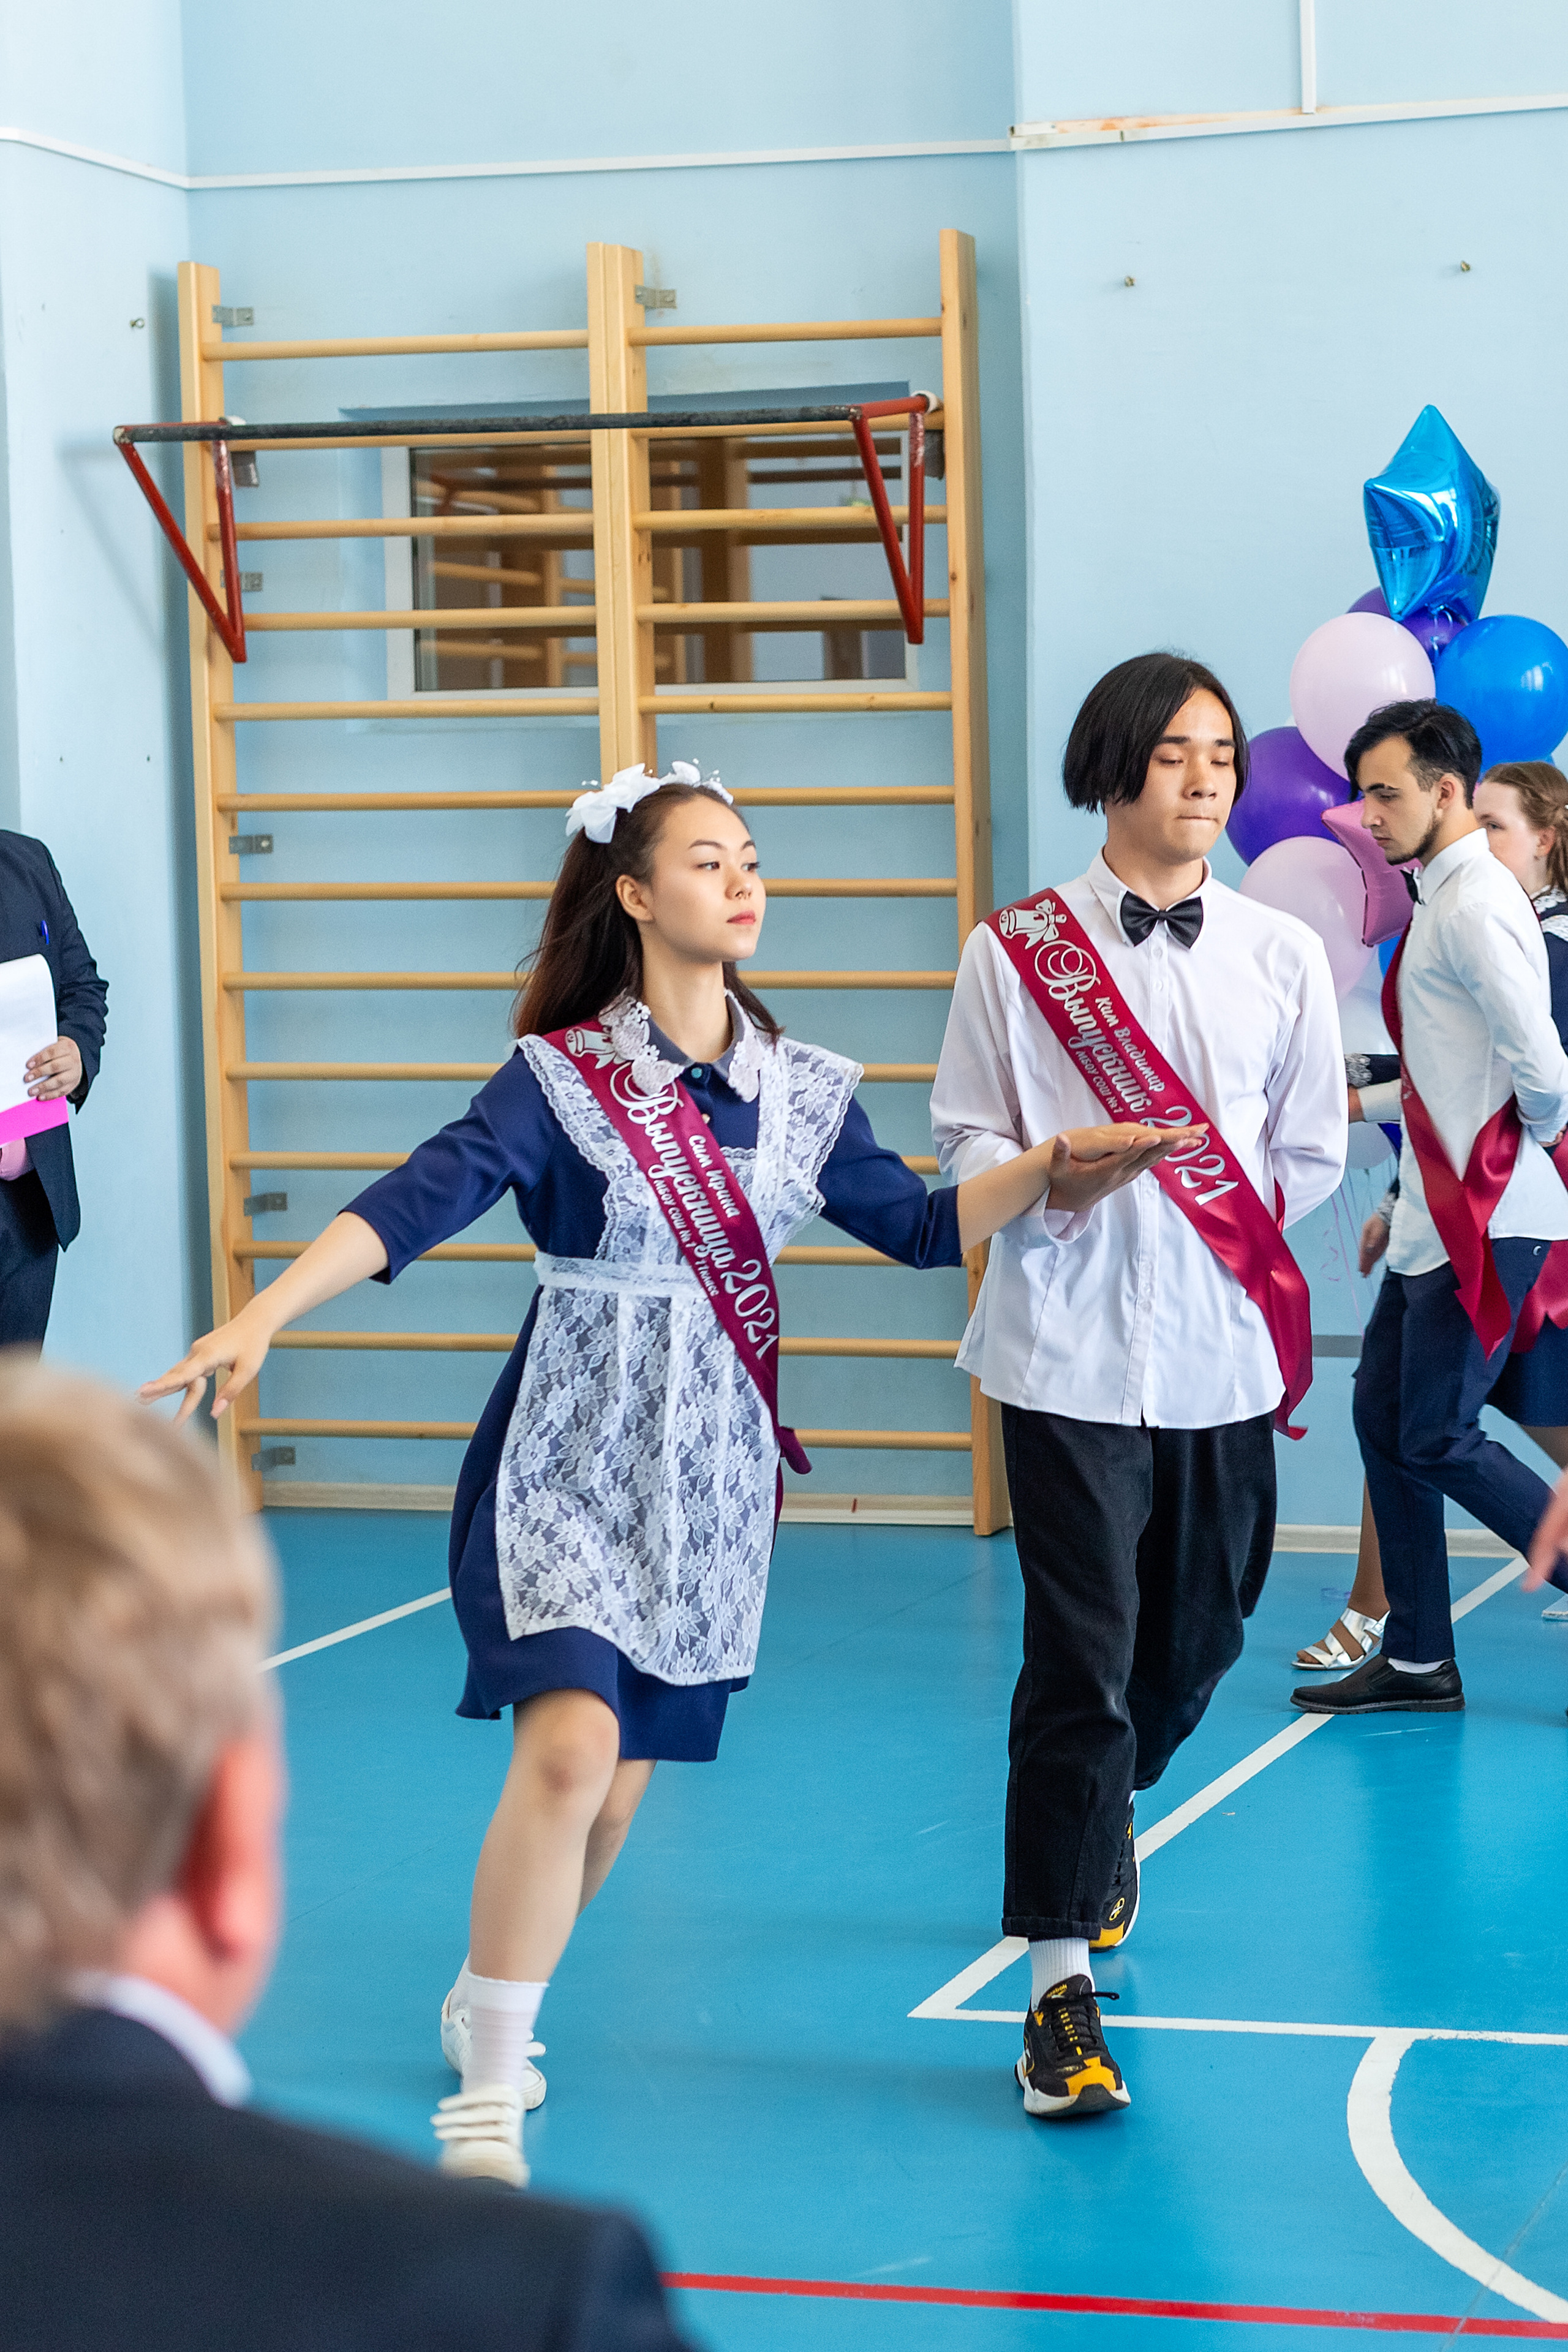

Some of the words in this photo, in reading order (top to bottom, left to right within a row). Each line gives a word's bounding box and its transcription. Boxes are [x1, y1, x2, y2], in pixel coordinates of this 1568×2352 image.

[1034, 939, 1152, 1114] Выпускник
[1095, 996, 1120, 1028] Ким
[1114, 1026, 1166, 1093] Владимир
[1075, 1050, 1099, 1075] МБОУ
[1092, 1076, 1112, 1096] СОШ
[609, 1061, 736, 1270] Выпускница
[720, 1259, 779, 1361] 2021
[653, 1179, 677, 1206] МБОУ
[668, 1207, 687, 1230] СОШ
[688, 1134, 714, 1169] Сим
[706, 1169, 741, 1219] Ирина
